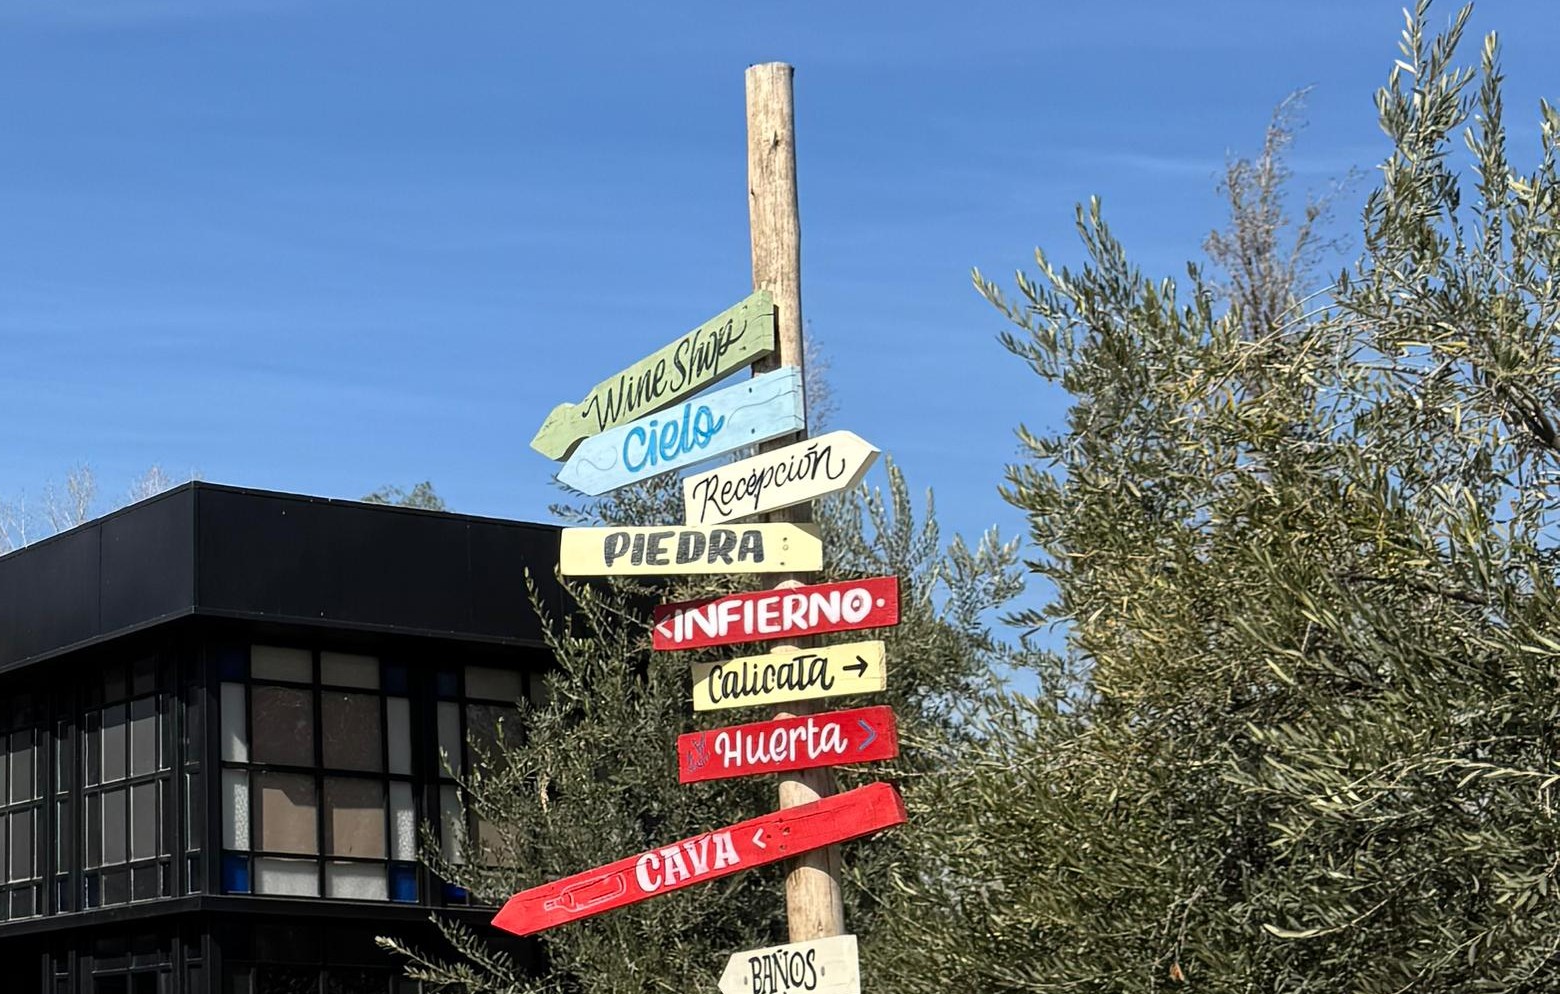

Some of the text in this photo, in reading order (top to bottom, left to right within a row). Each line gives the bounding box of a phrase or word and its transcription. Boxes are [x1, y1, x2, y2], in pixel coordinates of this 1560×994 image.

[582, 318, 748, 432] Wine Shop
[623, 402, 725, 473] Cielo
[692, 443, 846, 523] Recepción
[603, 530, 765, 567] PIEDRA
[714, 718, 848, 768] Huerta
[635, 831, 740, 892] CAVA
[748, 948, 817, 994] BAÑOS
